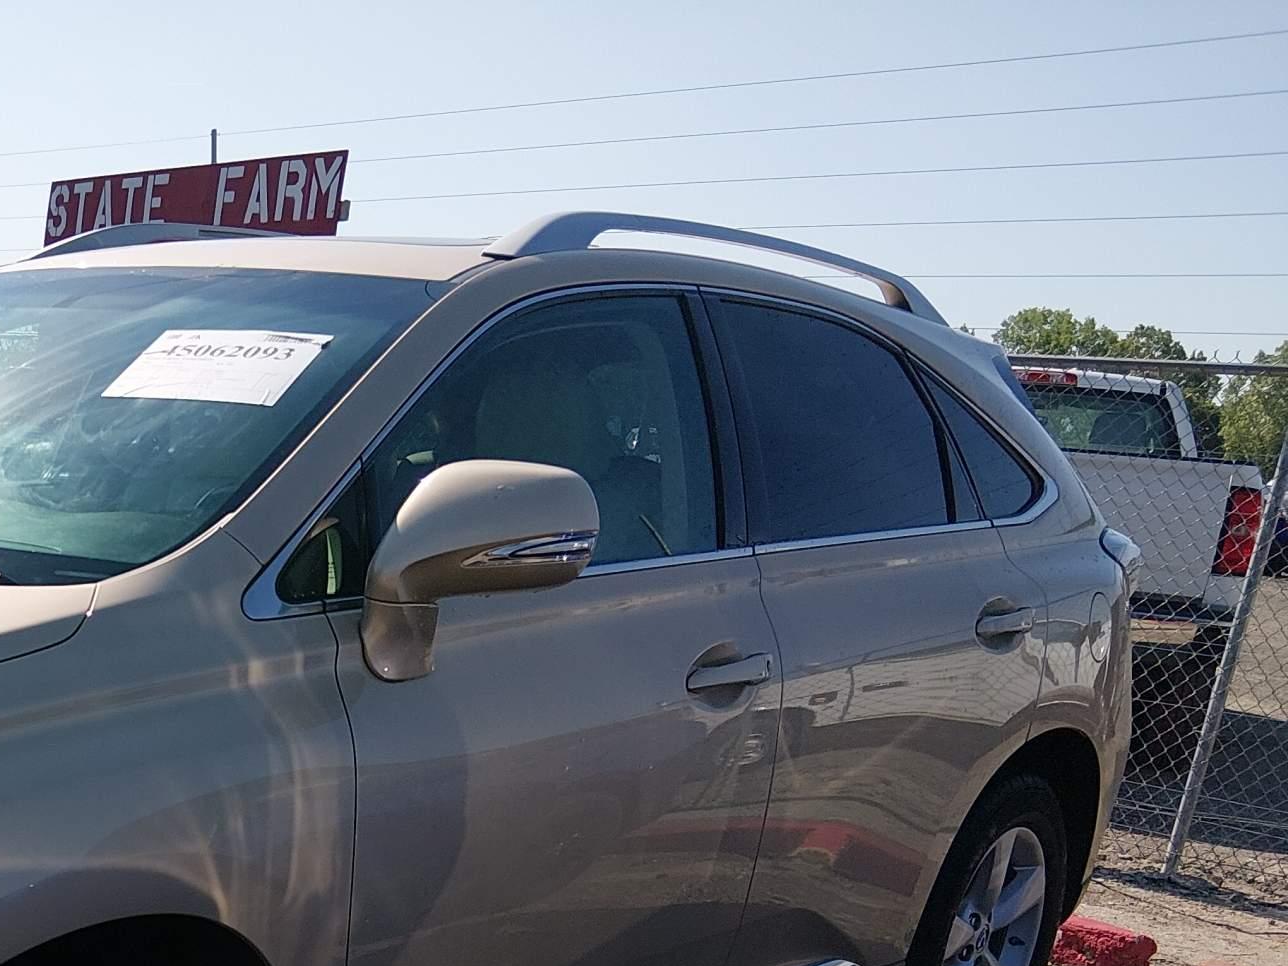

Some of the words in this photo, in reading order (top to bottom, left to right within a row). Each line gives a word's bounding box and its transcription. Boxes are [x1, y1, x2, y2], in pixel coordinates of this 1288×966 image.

[46, 174, 170, 238] STATE
[213, 155, 345, 226] FARM
[166, 344, 296, 361] 45062093
